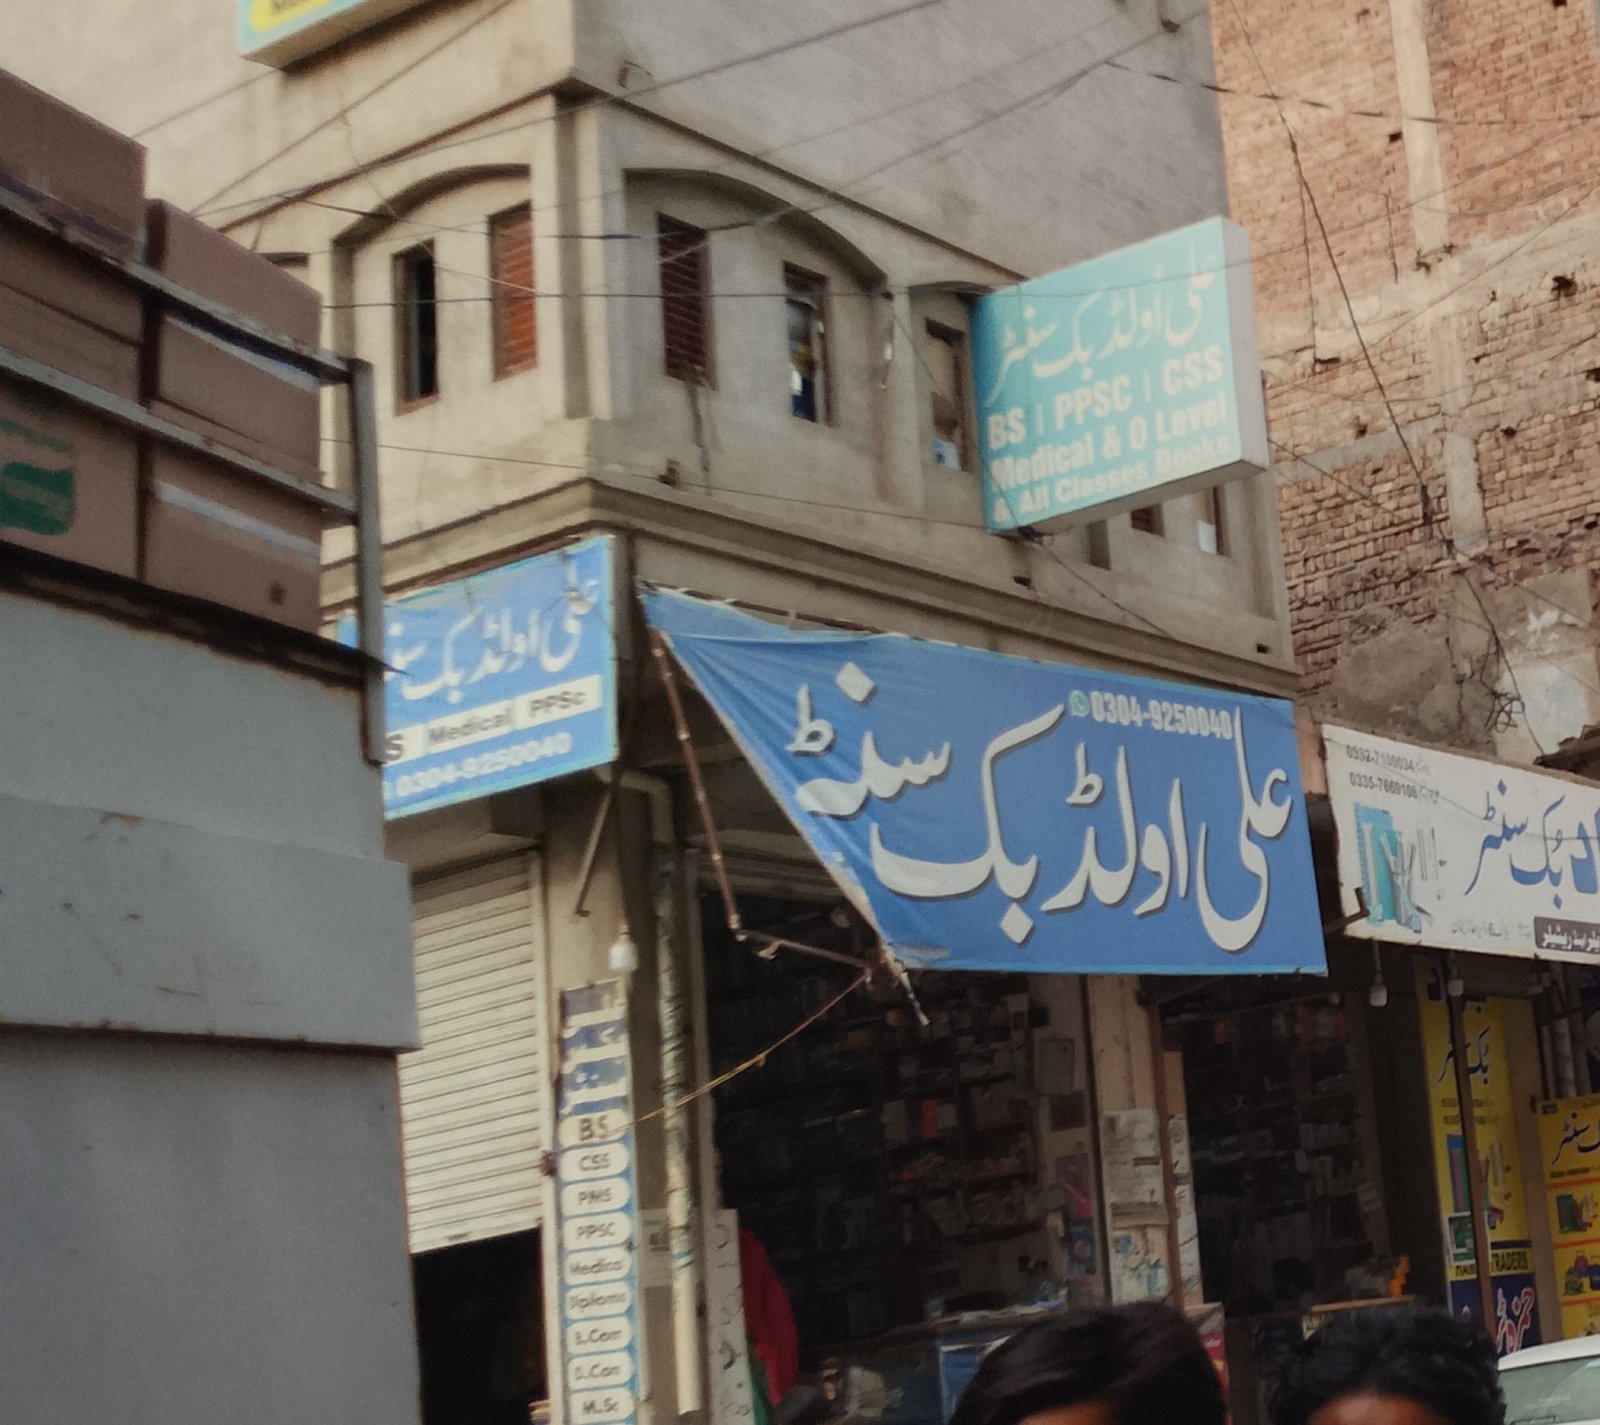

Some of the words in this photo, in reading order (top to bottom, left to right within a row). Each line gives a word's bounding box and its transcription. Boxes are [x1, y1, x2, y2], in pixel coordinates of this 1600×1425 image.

[1167, 239, 1217, 348] علی
[985, 305, 1061, 408] سنٹر
[987, 406, 1026, 451] BS
[1055, 375, 1132, 430] PPSC
[1162, 345, 1224, 397] CSS
[990, 432, 1094, 492] Medical
[1103, 425, 1122, 460] &
[1129, 416, 1148, 450] O
[1155, 389, 1228, 443] Level
[1018, 484, 1049, 514] All
[1055, 461, 1149, 504] Classes
[1154, 435, 1232, 477] Books
[427, 706, 517, 743] Medical
[784, 662, 951, 820] سنٹ
[1090, 690, 1233, 740] 0304-9250040
[870, 703, 1066, 945] بک
[1041, 742, 1190, 916] اولڈ
[1198, 704, 1294, 953] علی
[1464, 779, 1529, 897] سنٹر
